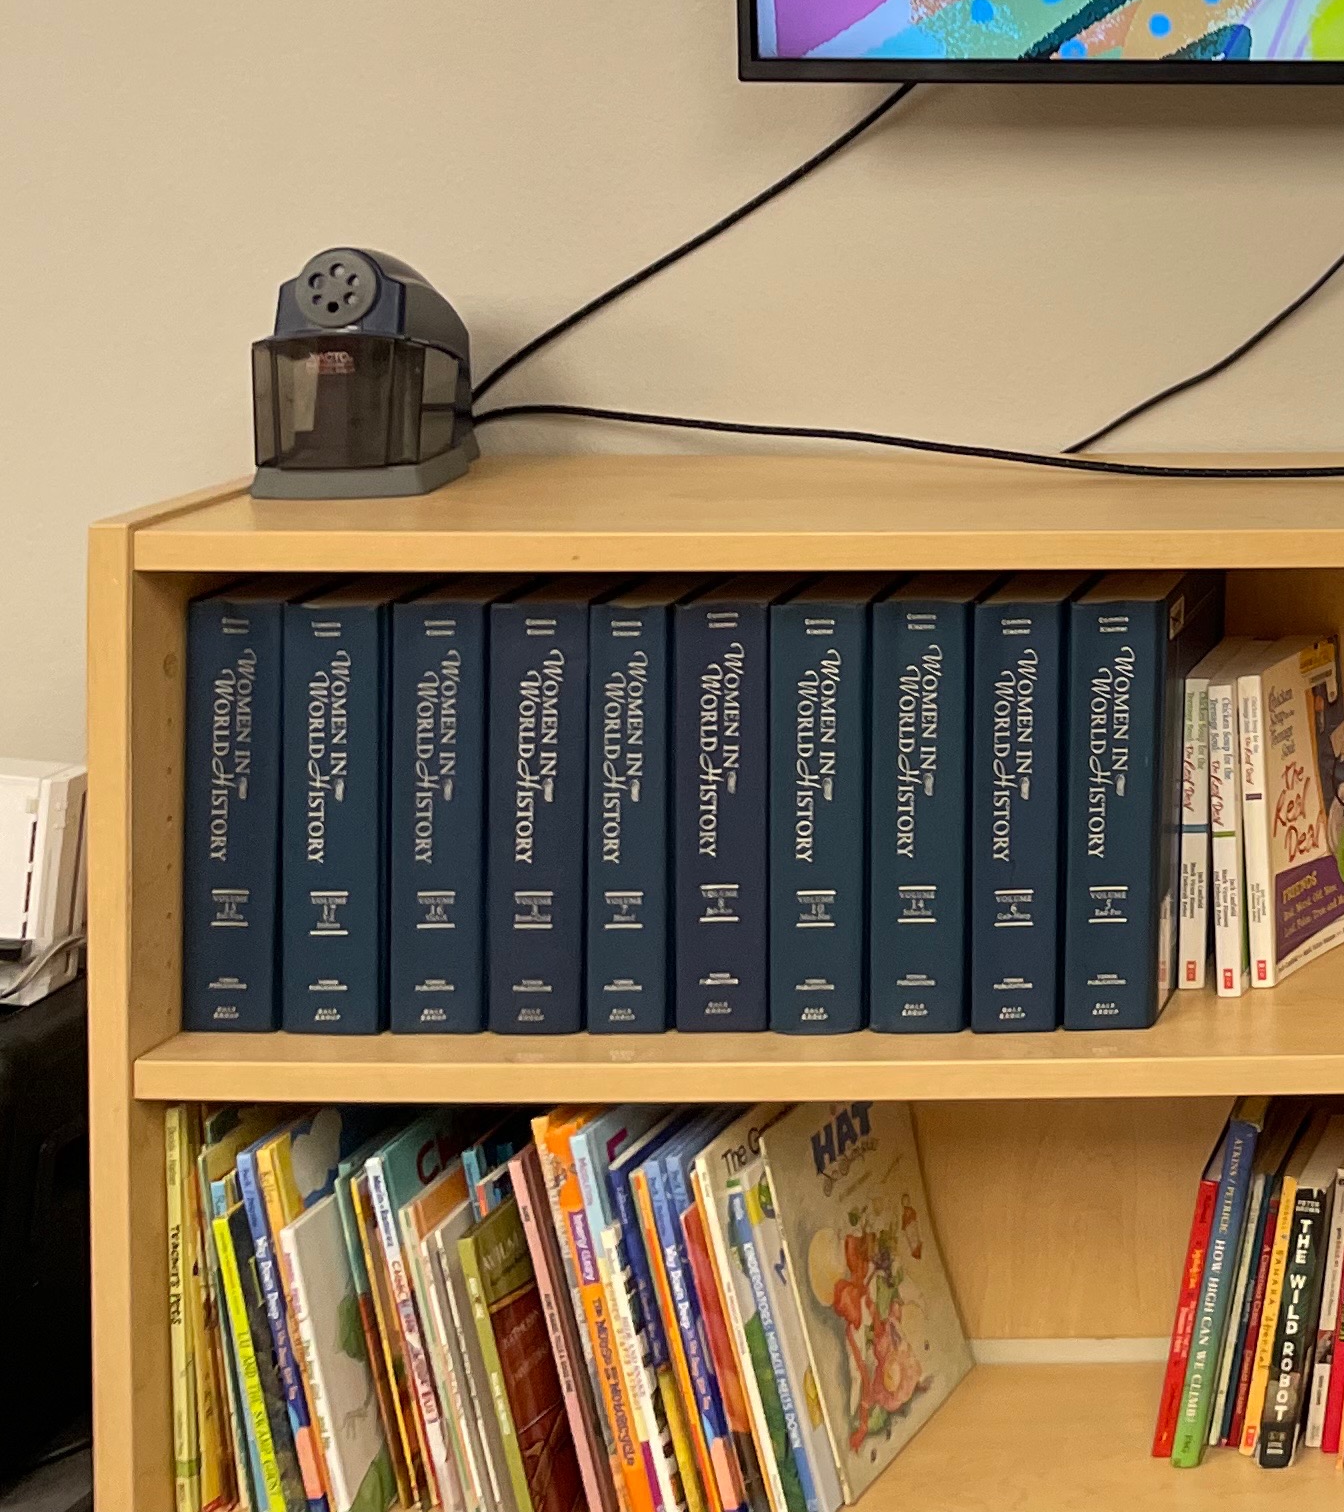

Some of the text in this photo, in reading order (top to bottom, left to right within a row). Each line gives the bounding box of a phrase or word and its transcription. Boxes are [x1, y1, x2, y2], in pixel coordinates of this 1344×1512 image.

[210, 669, 237, 862] WORLD HISTORY
[234, 648, 256, 774] WOMEN IN
[306, 671, 331, 864] WORLD HISTORY
[330, 650, 351, 776] WOMEN IN
[415, 671, 440, 864] WORLD HISTORY
[439, 650, 461, 775] WOMEN IN
[514, 670, 542, 864] WORLD HISTORY
[539, 649, 565, 776] WOMEN IN
[601, 672, 627, 864] WORLD HISTORY
[625, 651, 648, 776] WOMEN IN
[698, 663, 724, 857] WORLD HISTORY
[722, 642, 745, 768] WOMEN IN
[796, 670, 820, 757] WORLD
[818, 648, 842, 775] WOMEN IN
[896, 665, 923, 858] WORLD HISTORY
[919, 644, 943, 770] WOMEN IN
[992, 670, 1018, 862] WORLD HISTORY
[1016, 648, 1039, 774] WOMEN IN
[1087, 668, 1114, 858] WORLD HISTORY
[1112, 646, 1136, 771] WOMEN IN
[795, 758, 822, 863] HISTORY
[1273, 777, 1311, 838] Real
[1284, 808, 1325, 863] Deal
[720, 1144, 748, 1176] The
[811, 1101, 874, 1176] HAT
[1203, 1276, 1221, 1313] HIGH
[1210, 1239, 1227, 1273] HOW
[1193, 1350, 1209, 1370] WE
[1197, 1316, 1214, 1346] CAN
[1273, 1219, 1316, 1423] THE WILD ROBOT
